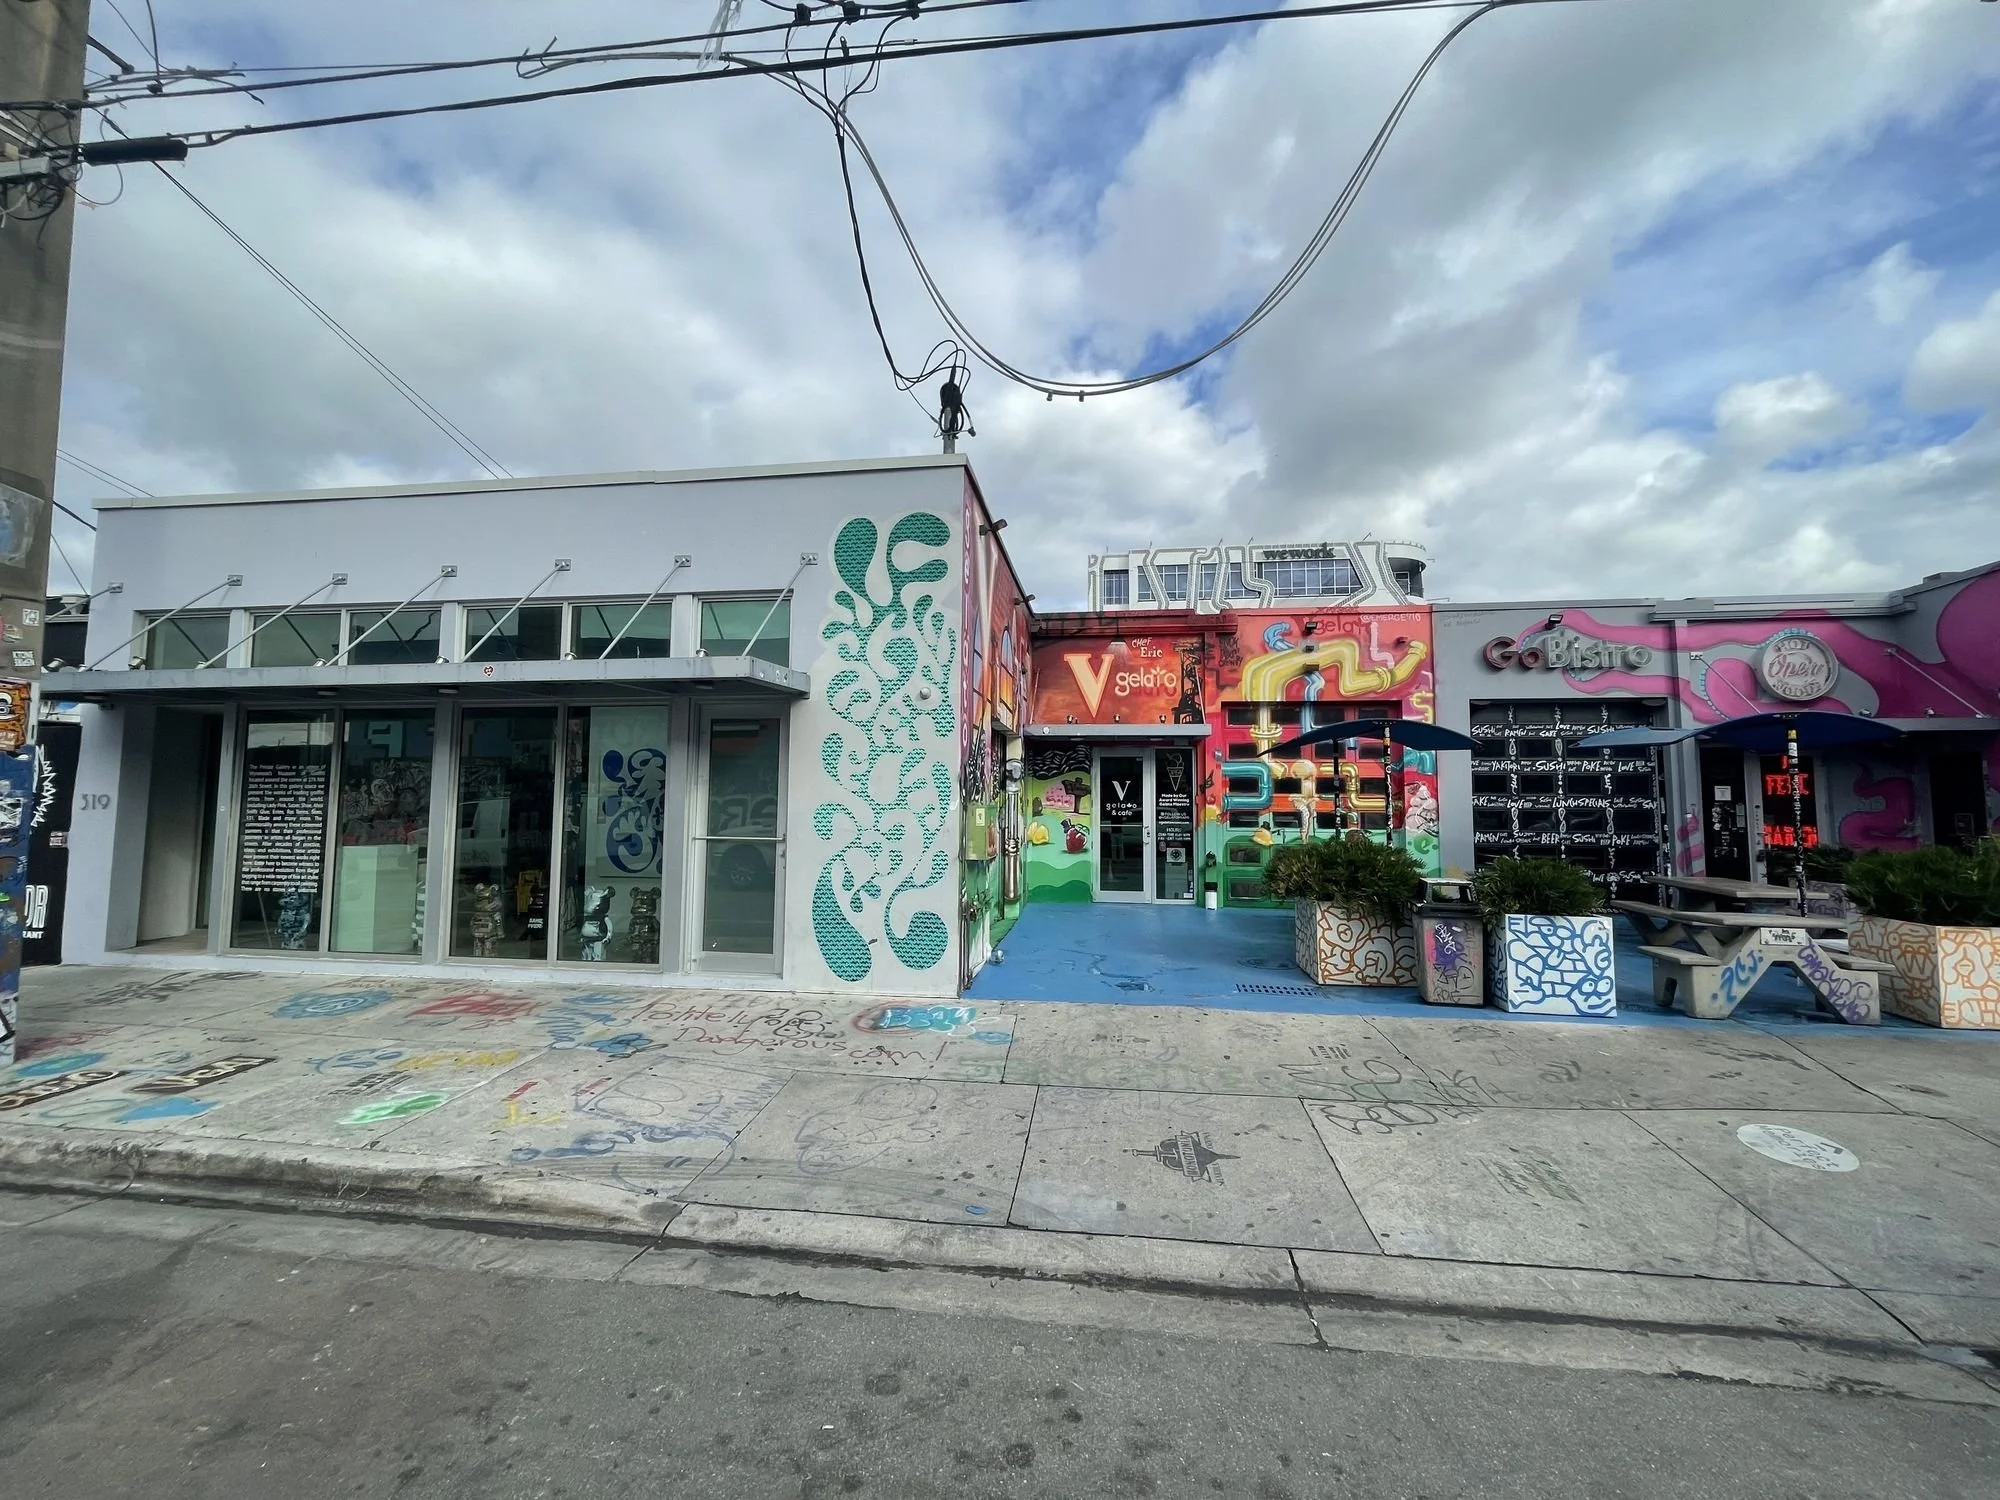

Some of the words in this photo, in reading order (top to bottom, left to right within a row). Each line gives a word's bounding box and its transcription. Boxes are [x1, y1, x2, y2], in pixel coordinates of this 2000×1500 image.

[1263, 542, 1336, 560] wework
[1140, 646, 1163, 658] Eric
[1063, 653, 1115, 718] V
[1115, 665, 1177, 697] gelato
[1472, 724, 1496, 736] SUSHI
[1586, 724, 1615, 735] SUSHI
[1504, 729, 1527, 737] RAMEN
[1536, 760, 1567, 772] SUSHI
[1582, 760, 1602, 772] POKE
[1618, 762, 1635, 772] LOVE
[1112, 780, 1132, 800] V
[1506, 799, 1526, 808] LOVE
[1474, 832, 1500, 844] RAMEN
[1541, 833, 1560, 844] BEER
[1612, 834, 1630, 846] POKE
